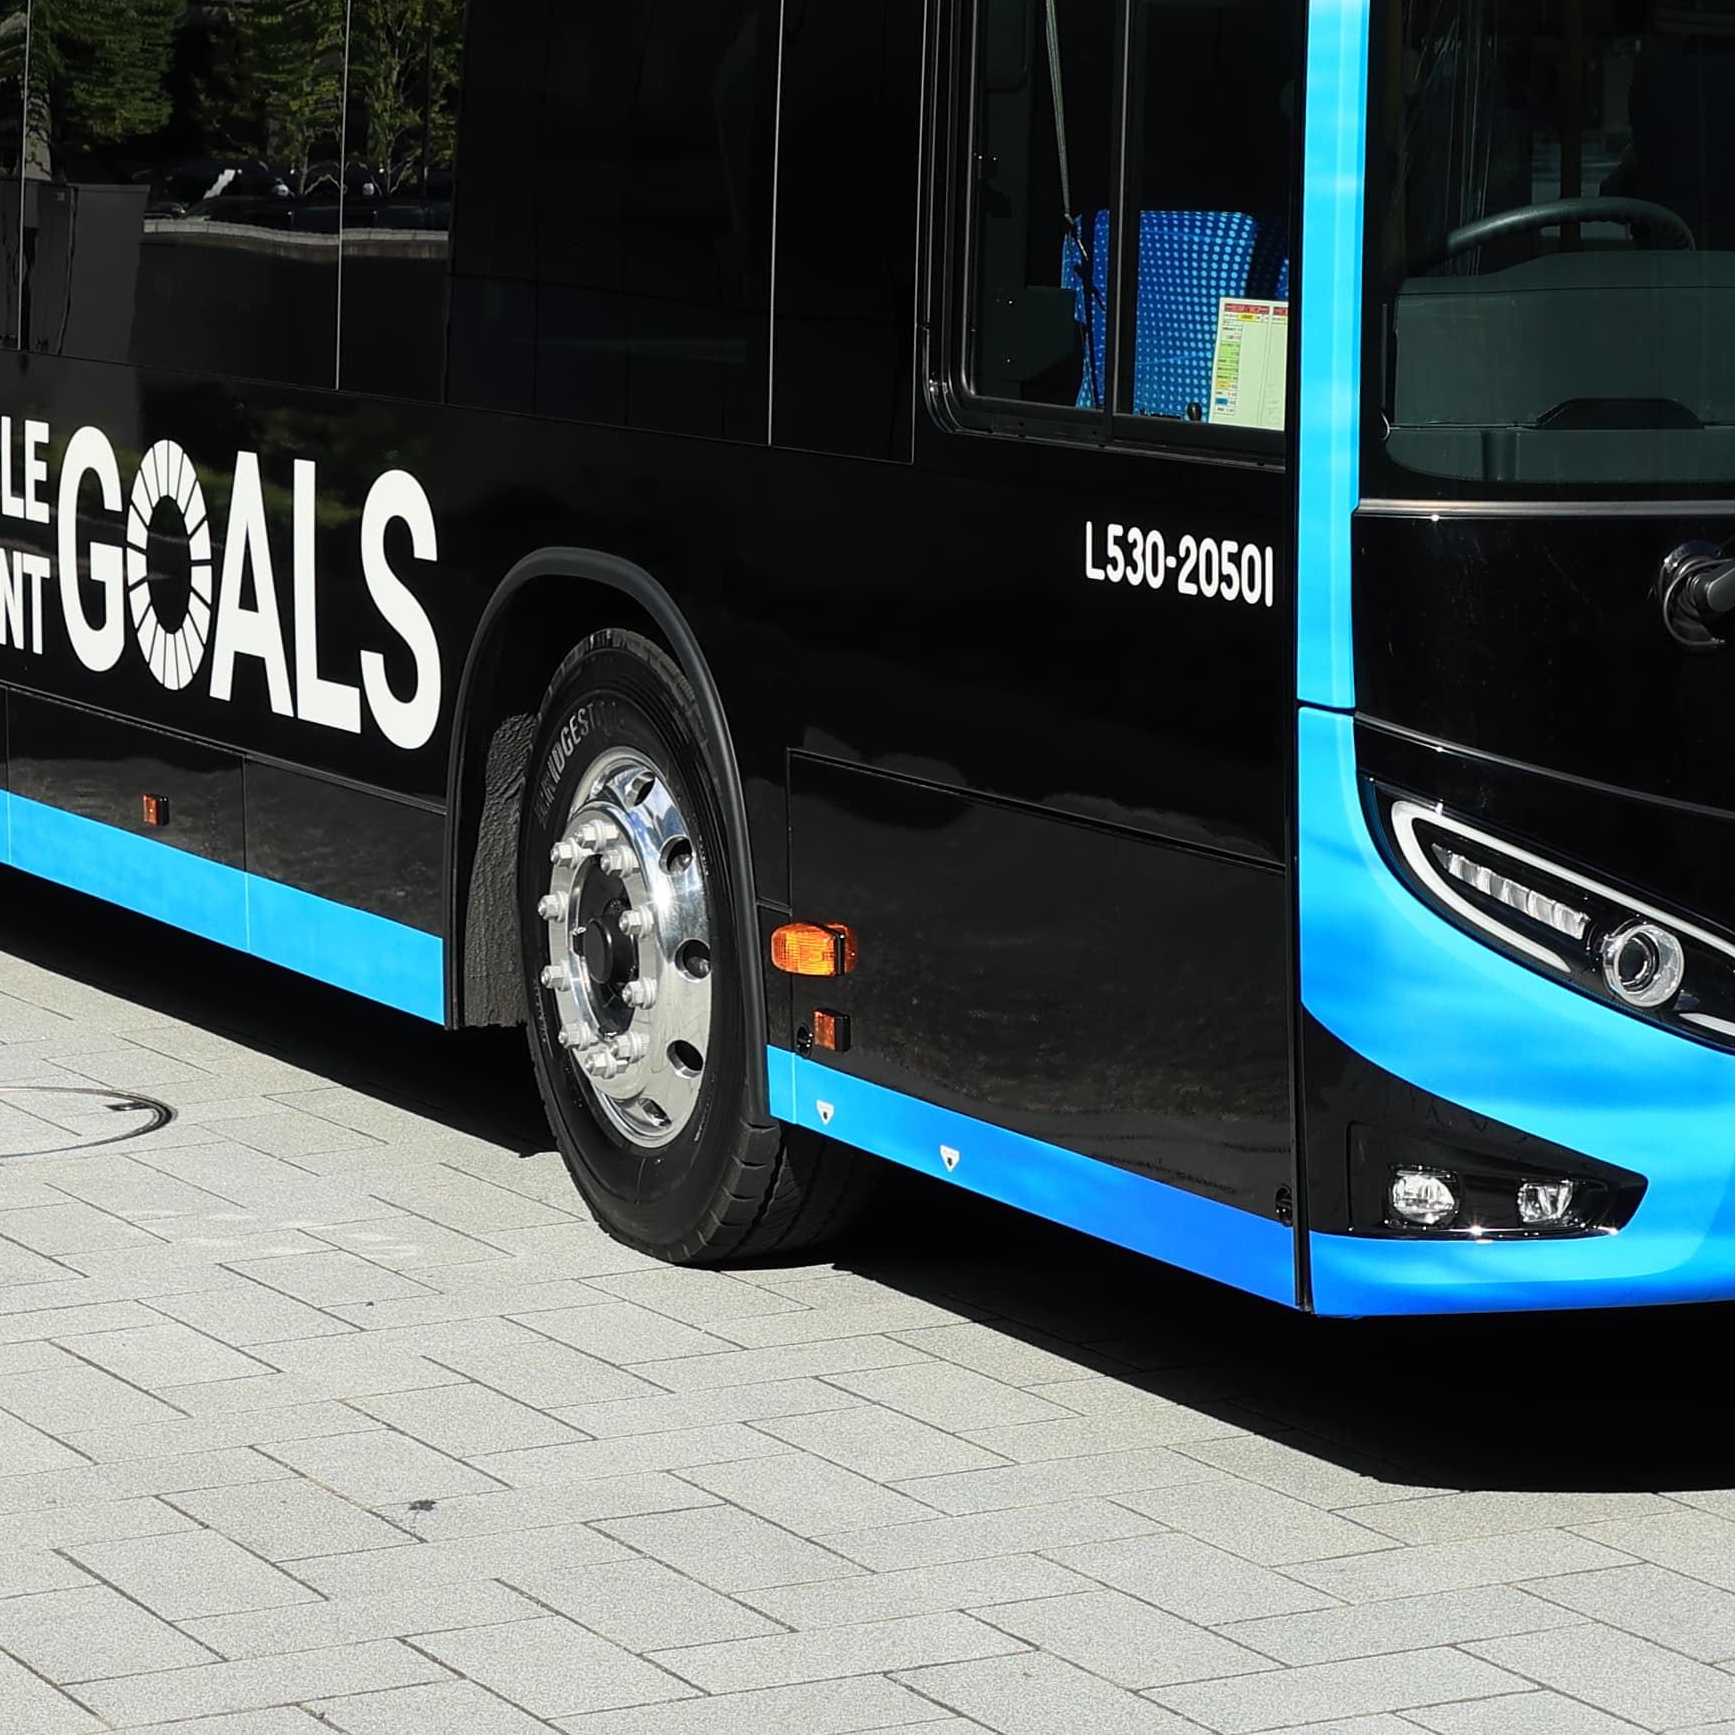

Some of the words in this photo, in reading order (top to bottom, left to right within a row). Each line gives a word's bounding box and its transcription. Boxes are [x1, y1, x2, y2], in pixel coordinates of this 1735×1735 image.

[57, 425, 442, 750] GOALS
[1084, 520, 1274, 607] L530-20501
[533, 699, 628, 830] BRIDGEST
